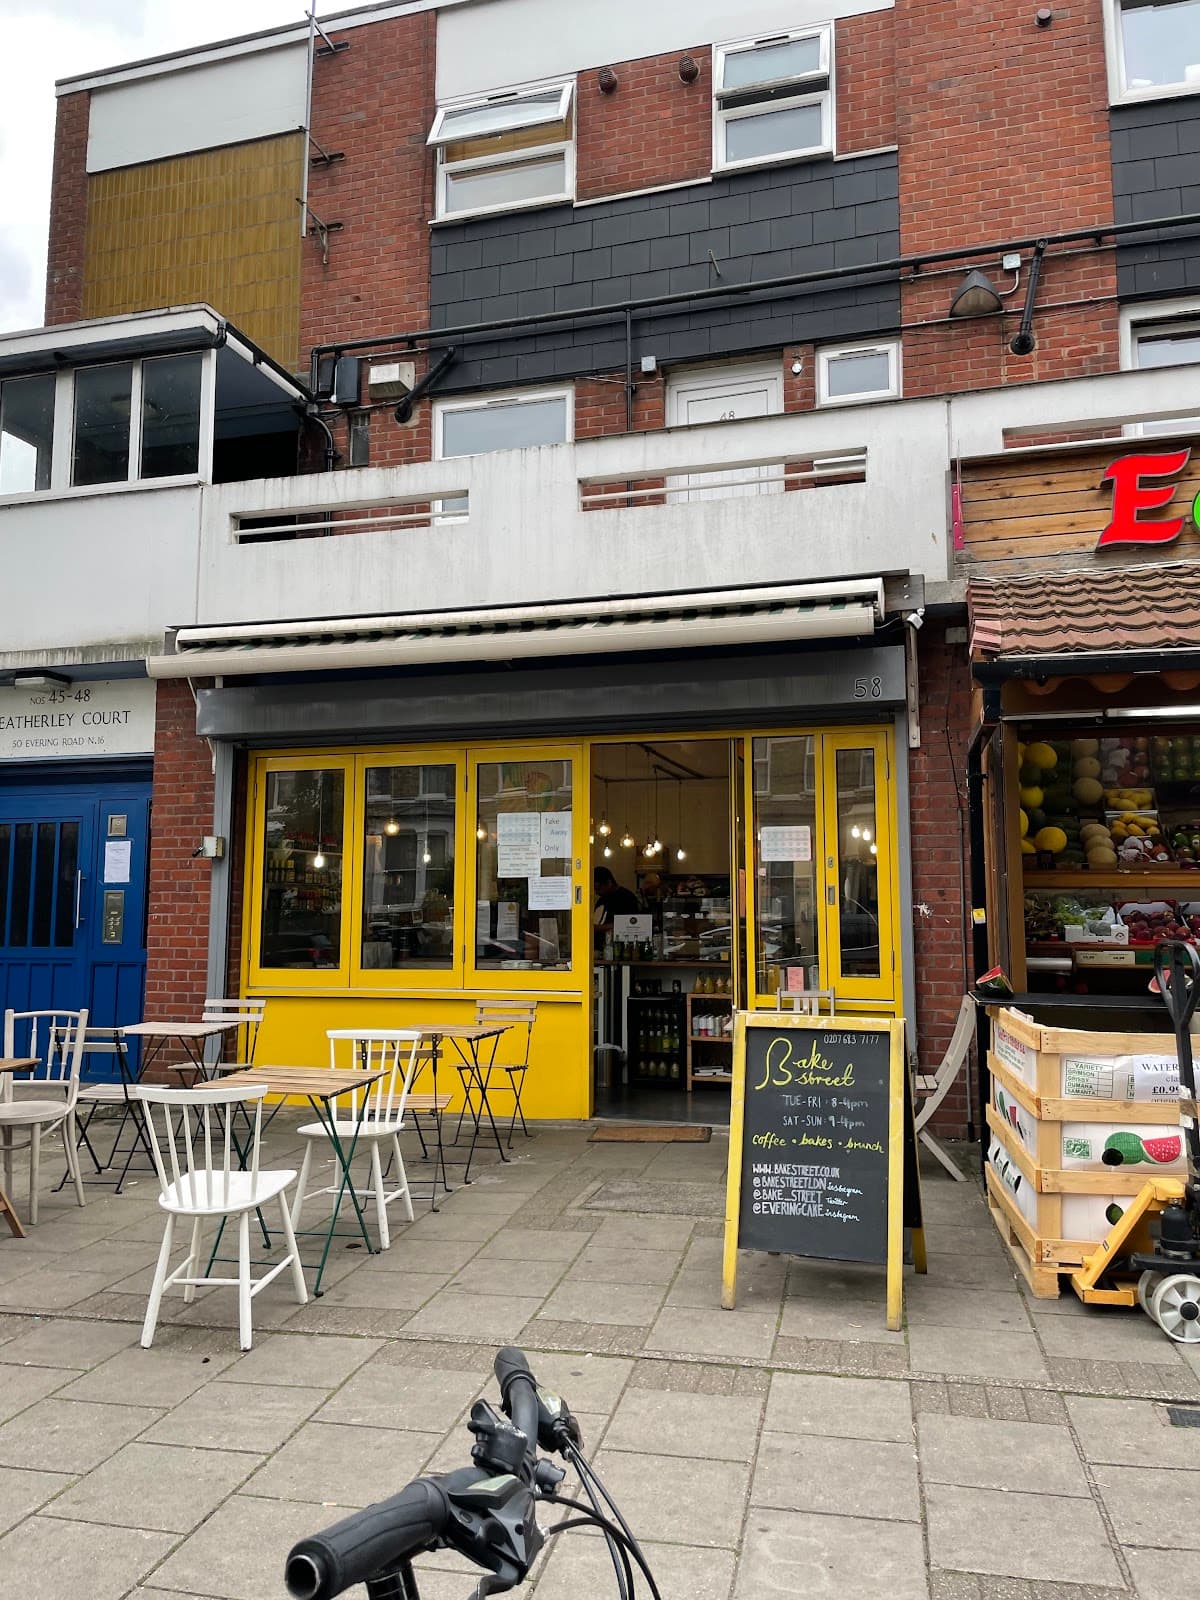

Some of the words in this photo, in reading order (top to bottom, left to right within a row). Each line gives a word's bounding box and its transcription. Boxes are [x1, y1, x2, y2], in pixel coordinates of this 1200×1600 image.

[1098, 446, 1200, 550] E
[48, 688, 91, 704] 45-48
[853, 677, 881, 698] 58
[82, 711, 131, 725] COURT
[26, 738, 58, 747] EVERING
[62, 737, 84, 746] ROAD
[544, 844, 559, 852] Only
[755, 1037, 834, 1090] Bake
[794, 1063, 856, 1087] street
[752, 1132, 787, 1149] coffee
[799, 1133, 833, 1149] bakes
[844, 1137, 885, 1153] brunch
